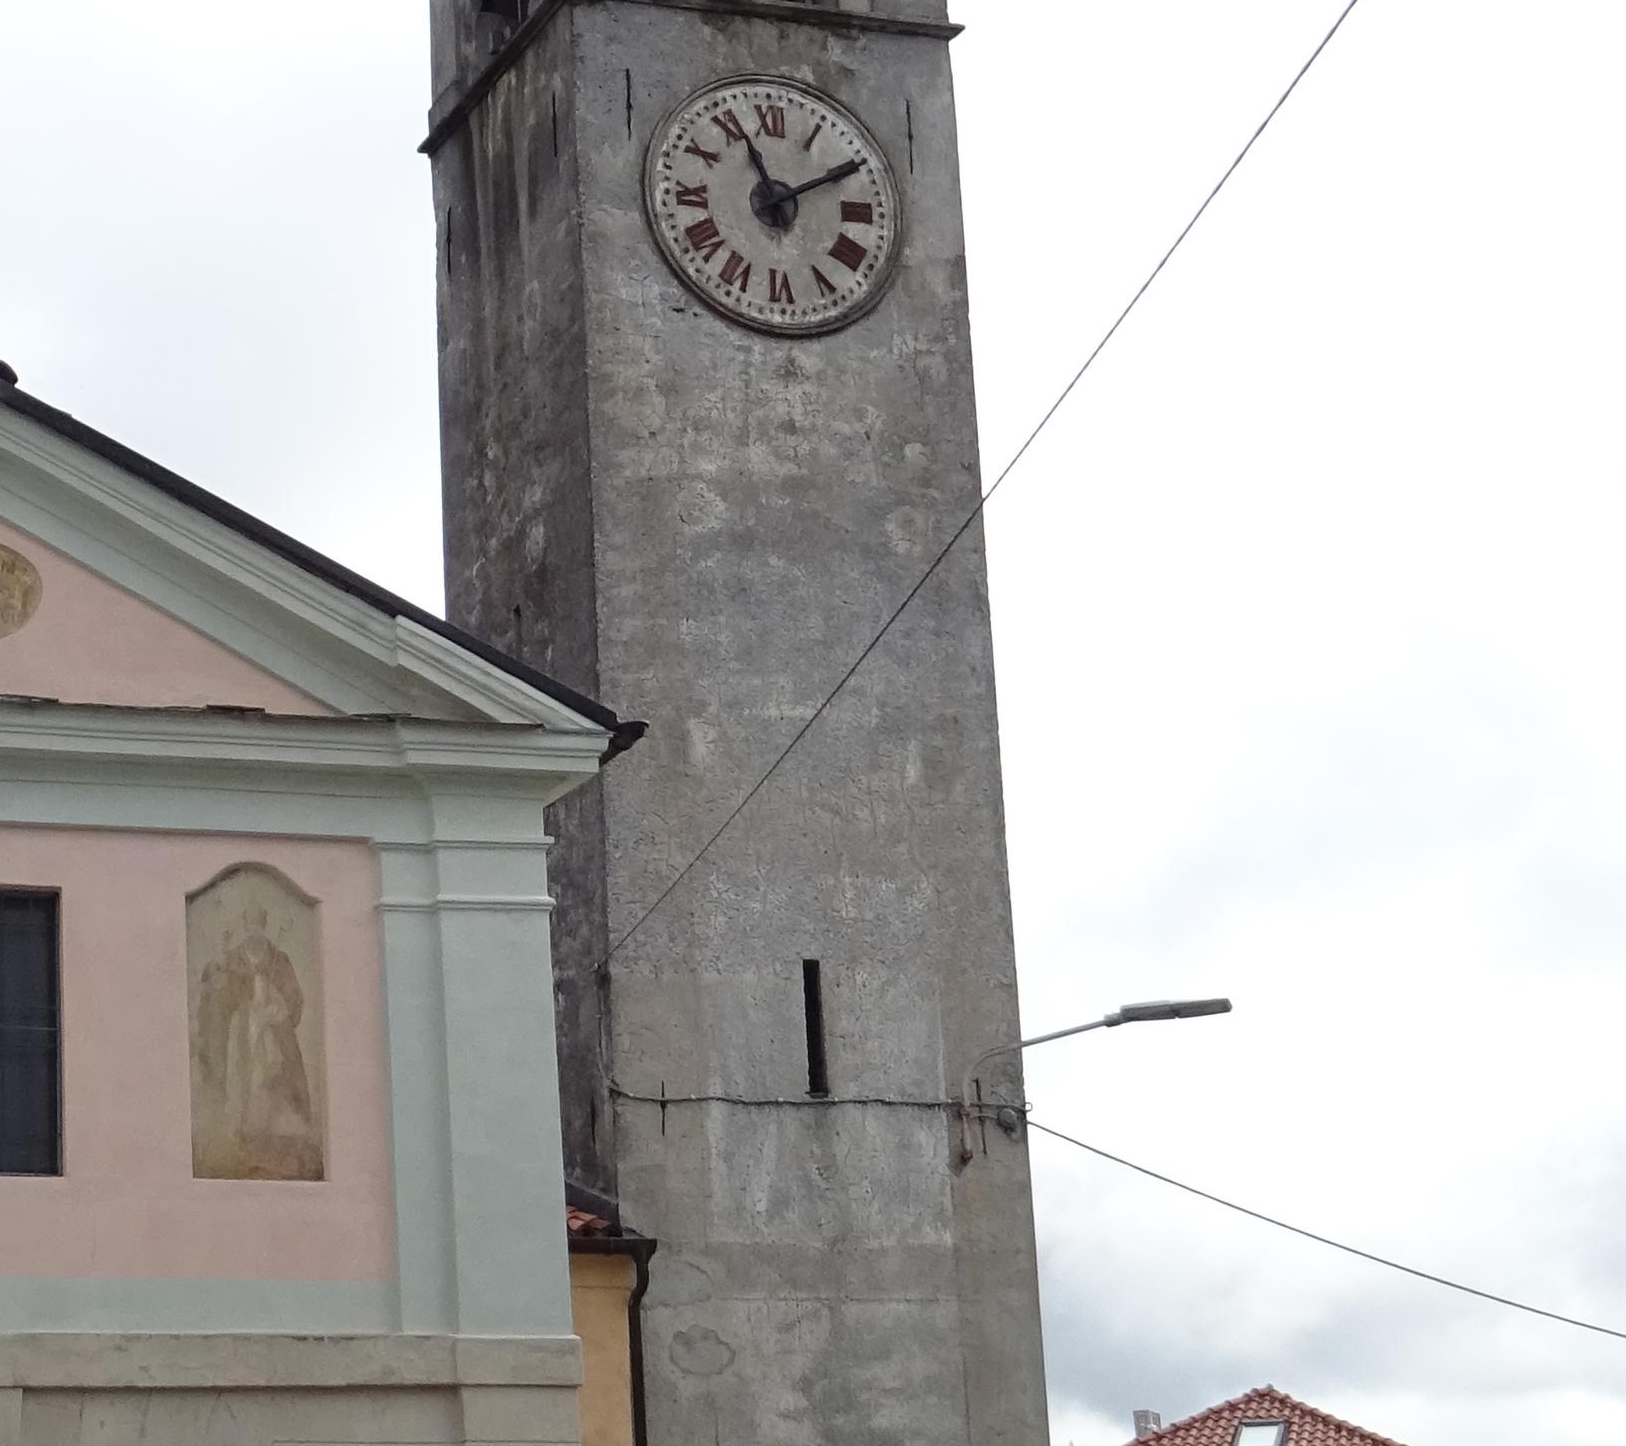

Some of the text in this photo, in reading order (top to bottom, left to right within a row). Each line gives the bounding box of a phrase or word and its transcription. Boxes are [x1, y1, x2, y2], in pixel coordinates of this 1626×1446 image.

[711, 108, 748, 147] XI
[754, 104, 786, 139] XII
[684, 139, 721, 169] X
[676, 181, 709, 209] IX
[769, 267, 796, 304] VI
[811, 264, 838, 297] V
